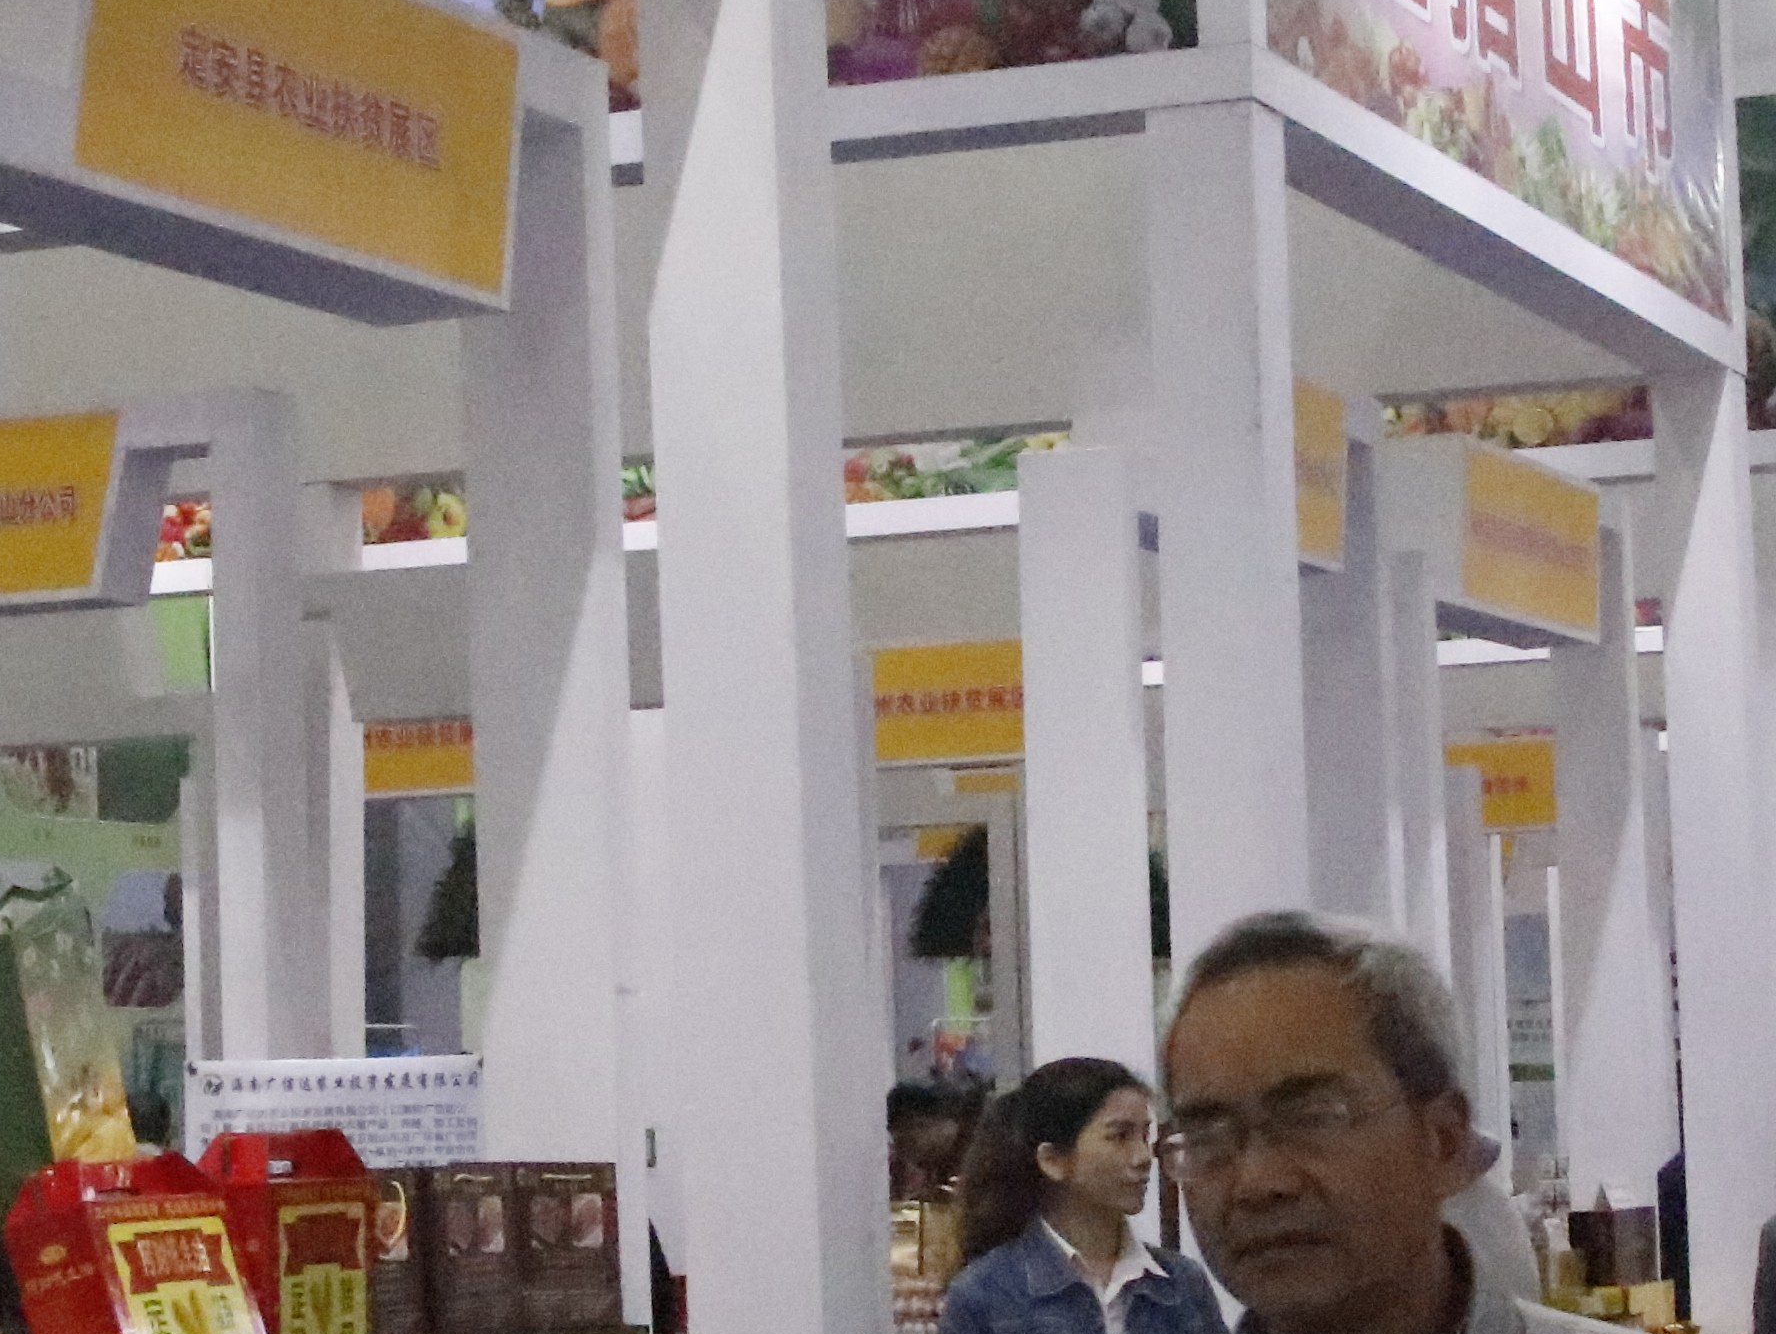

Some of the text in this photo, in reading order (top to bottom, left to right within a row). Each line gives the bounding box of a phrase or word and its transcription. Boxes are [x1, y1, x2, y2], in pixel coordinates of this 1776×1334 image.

[180, 23, 441, 171] 定安县农业扶贫展区
